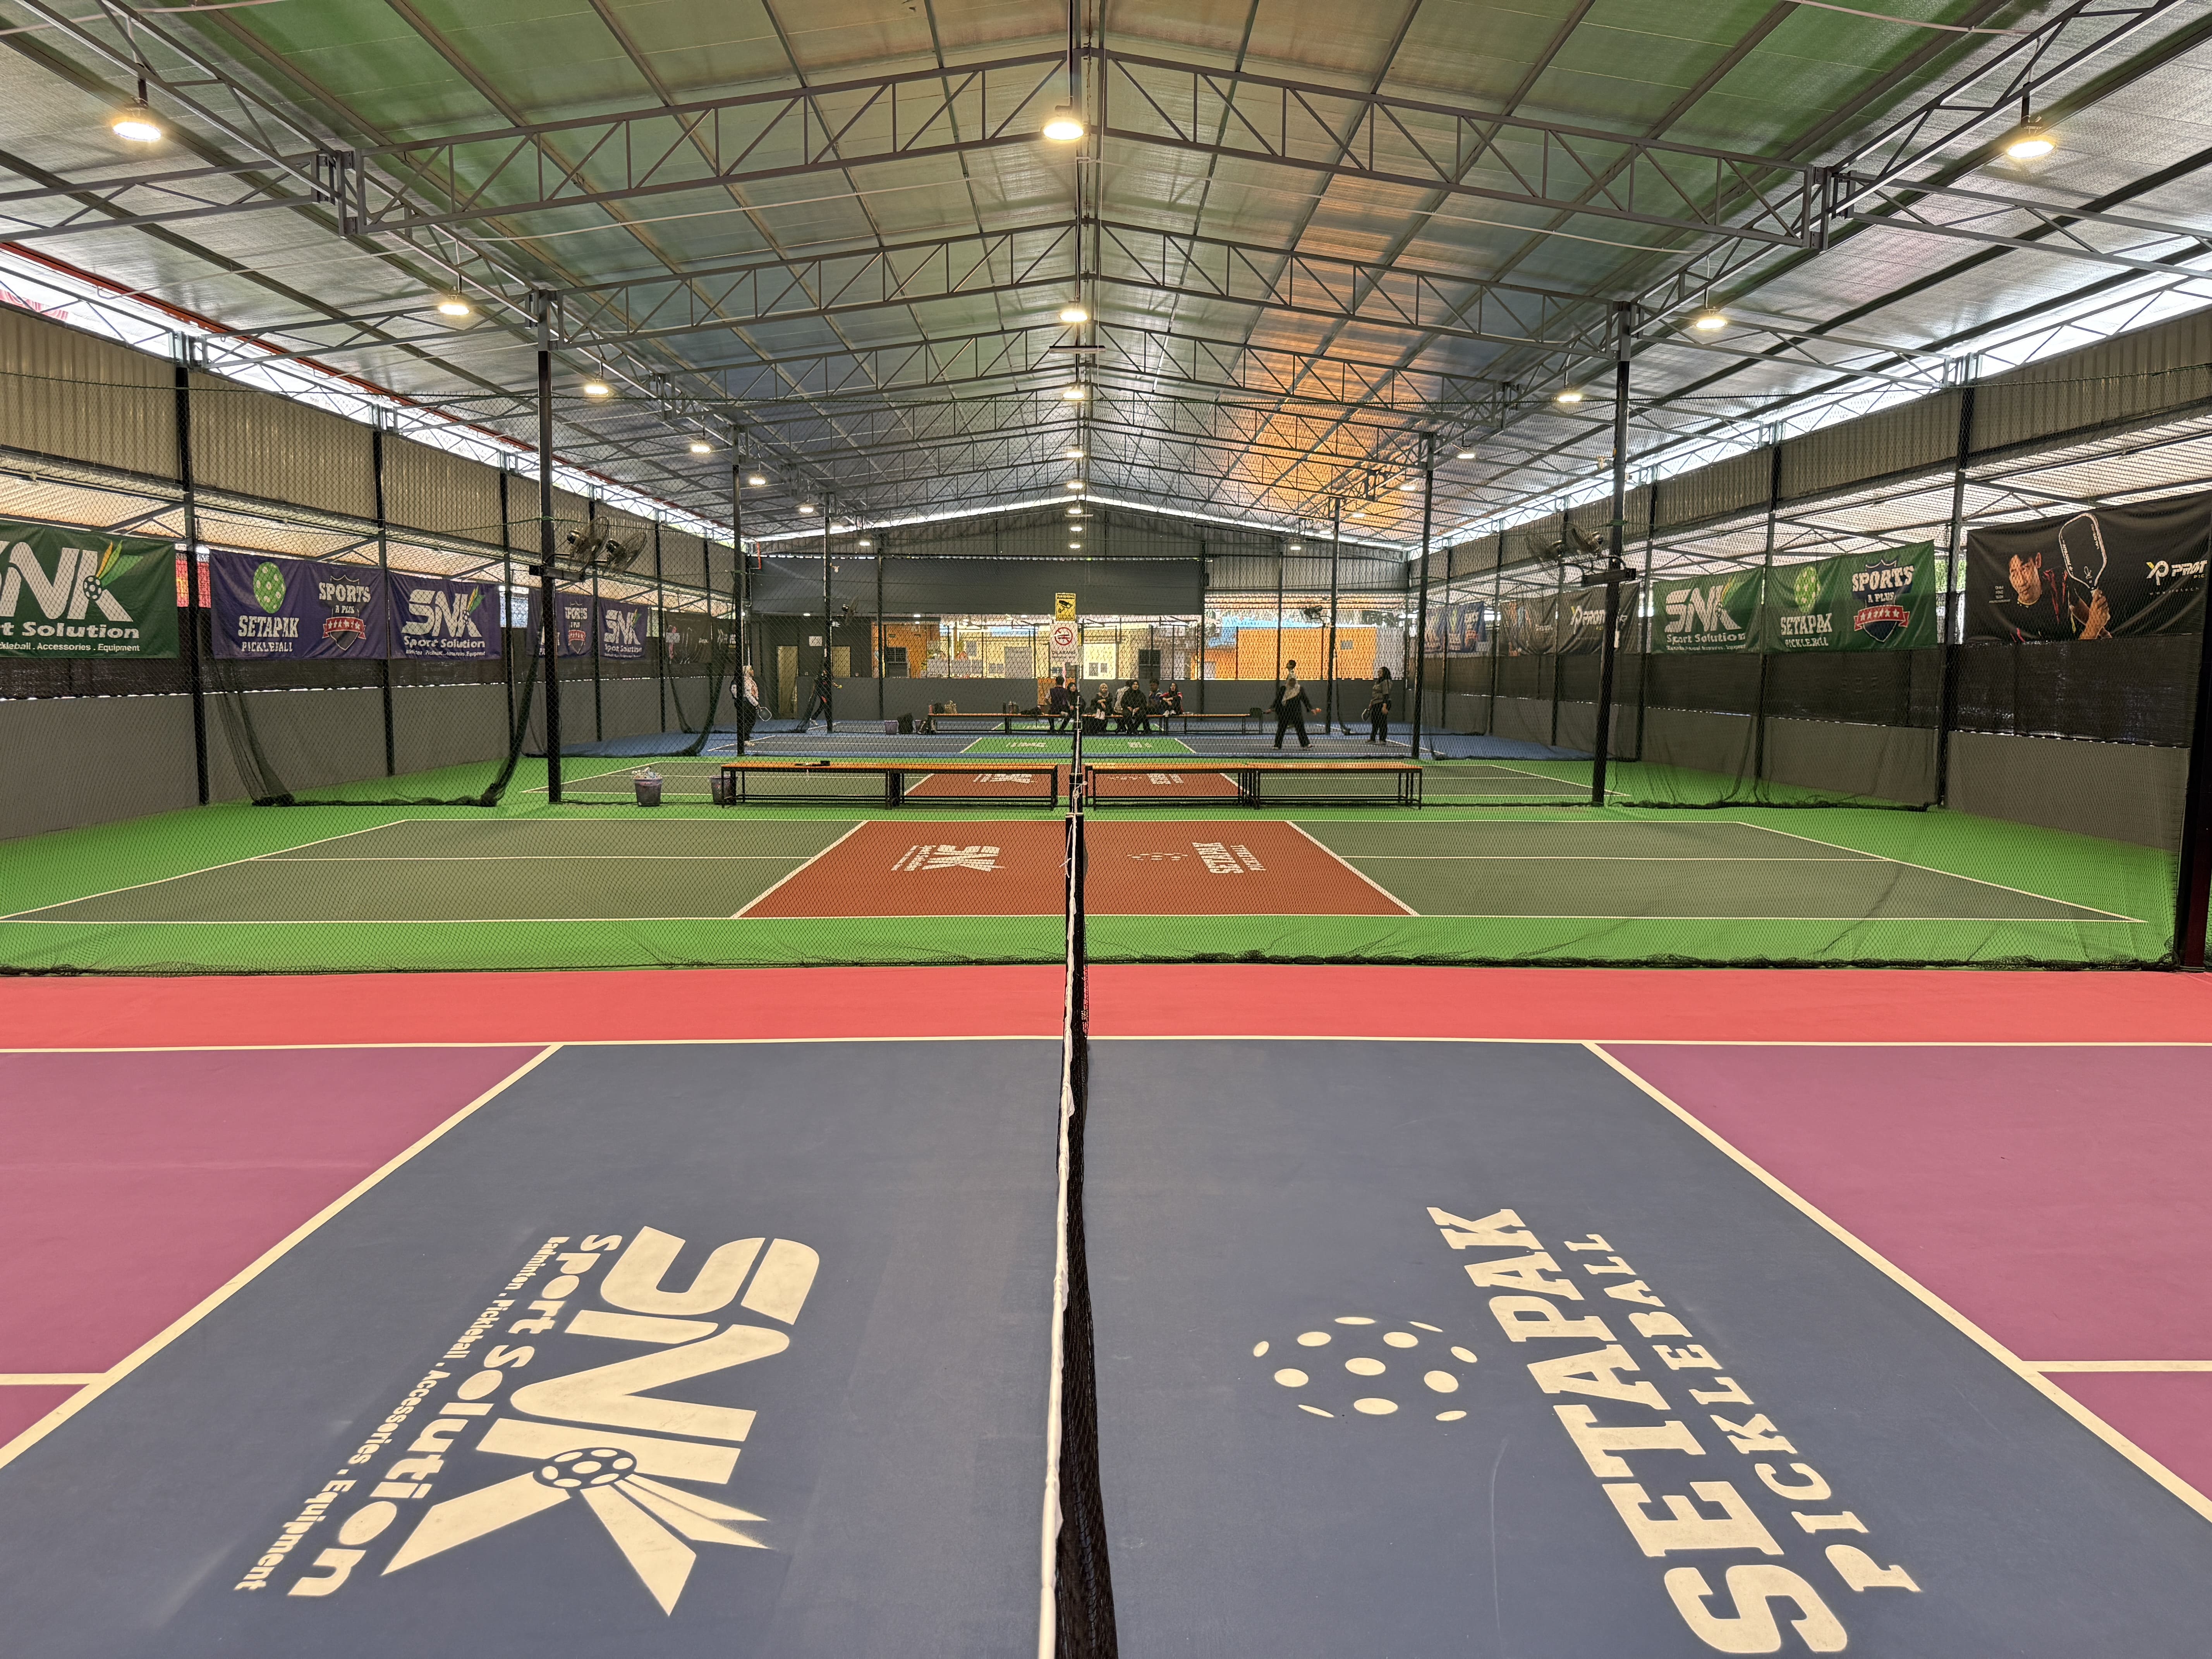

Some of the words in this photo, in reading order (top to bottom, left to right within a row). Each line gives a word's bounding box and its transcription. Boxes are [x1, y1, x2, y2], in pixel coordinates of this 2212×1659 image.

[0, 541, 134, 622] NK
[319, 582, 371, 603] SPORTS
[1852, 565, 1914, 592] SPORTS
[1868, 594, 1873, 603] A
[1875, 592, 1895, 603] PLUS
[22, 622, 139, 639] Solution
[239, 615, 299, 638] SETAPAK
[401, 589, 483, 637] SNK
[604, 610, 641, 645] SNK
[1664, 585, 1742, 633] SNK
[1781, 613, 1832, 635] SETAPAK
[38, 642, 91, 651] Accessories
[98, 643, 140, 653] Equipment
[404, 635, 438, 648] Sport
[440, 639, 485, 648] Solution
[1667, 634, 1692, 645] Sport
[1695, 632, 1745, 643] Solution
[507, 1236, 570, 1291] Badminton
[507, 1234, 623, 1336] Sport
[443, 1299, 516, 1360] Pickleball
[347, 1370, 451, 1465] Accessories
[382, 1226, 820, 1617] SNK
[1426, 1207, 1848, 1654] SETAPAK
[1563, 1234, 1923, 1592] PICKLEBALL
[287, 1344, 536, 1597] Solution
[234, 1479, 357, 1592] Equipment
